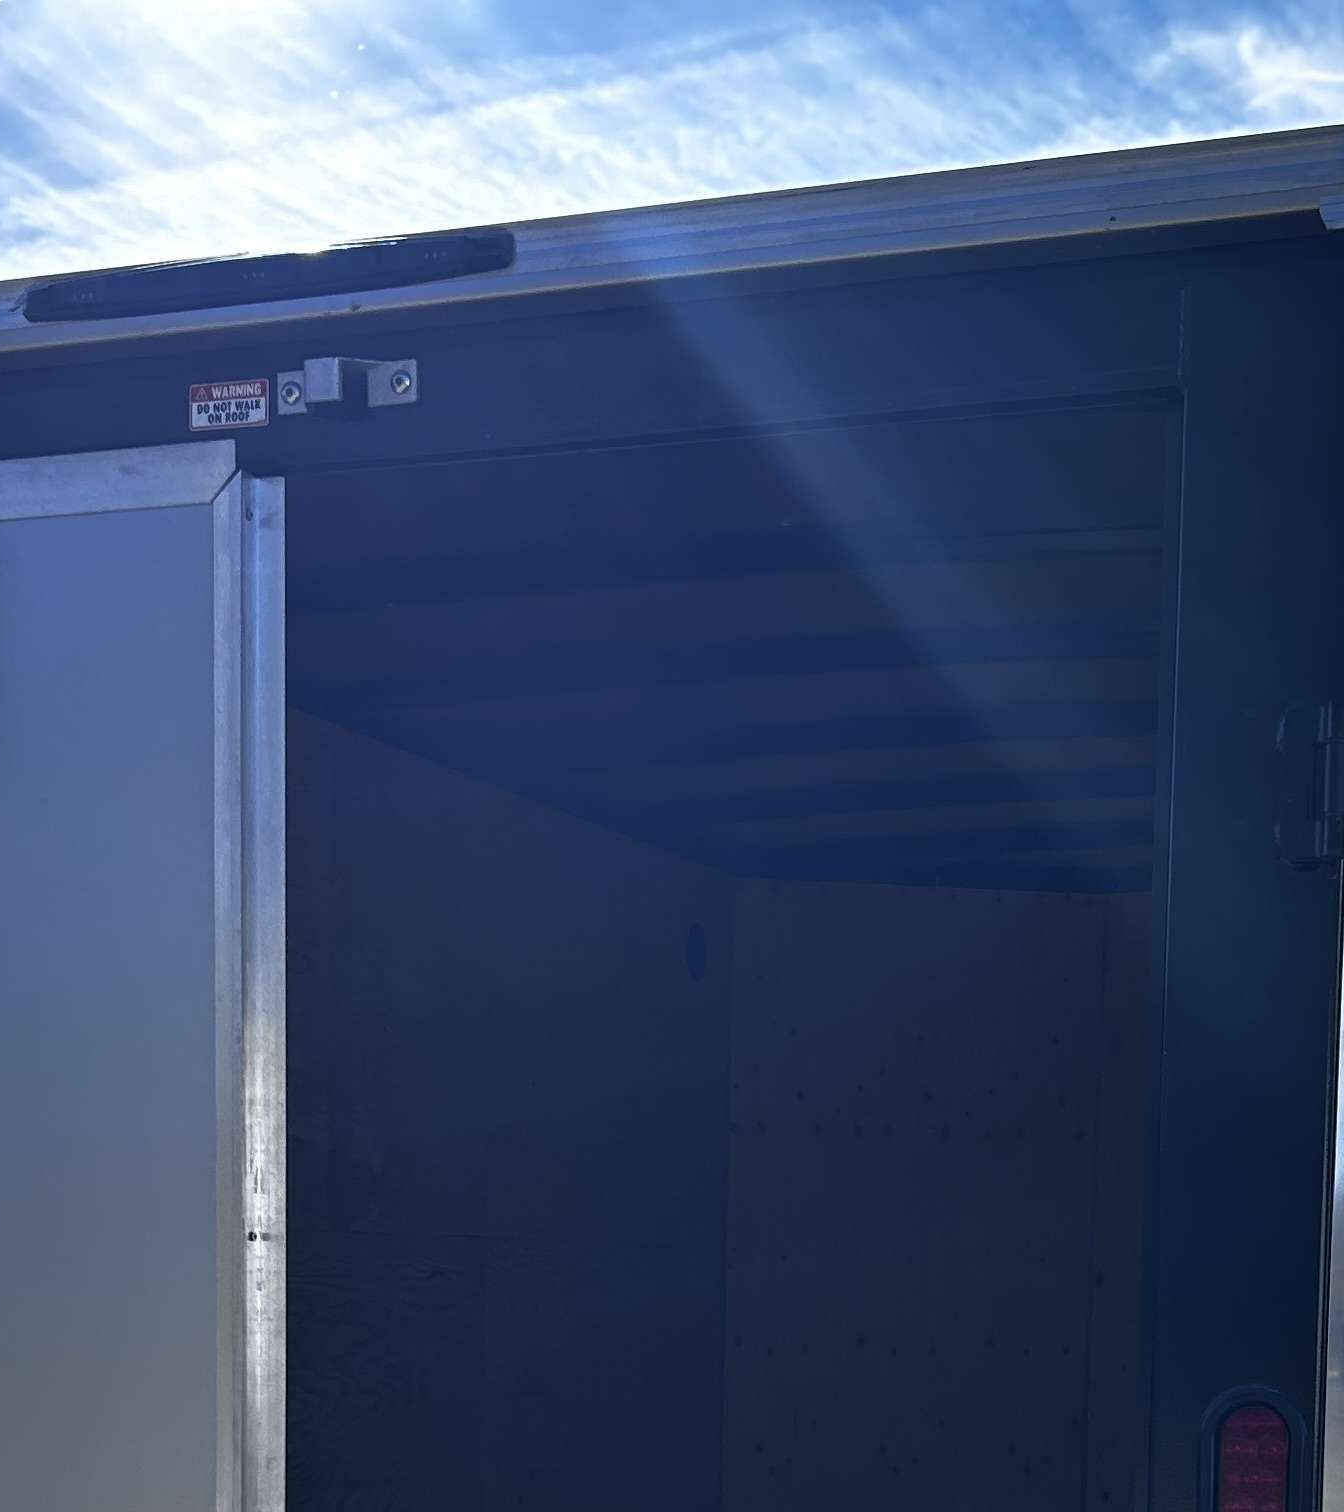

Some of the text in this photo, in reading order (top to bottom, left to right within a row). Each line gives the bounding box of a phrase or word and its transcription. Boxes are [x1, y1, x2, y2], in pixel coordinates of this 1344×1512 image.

[211, 382, 262, 399] WARNING
[197, 398, 261, 415] DO NOT WALK
[208, 411, 250, 424] ON ROOF
